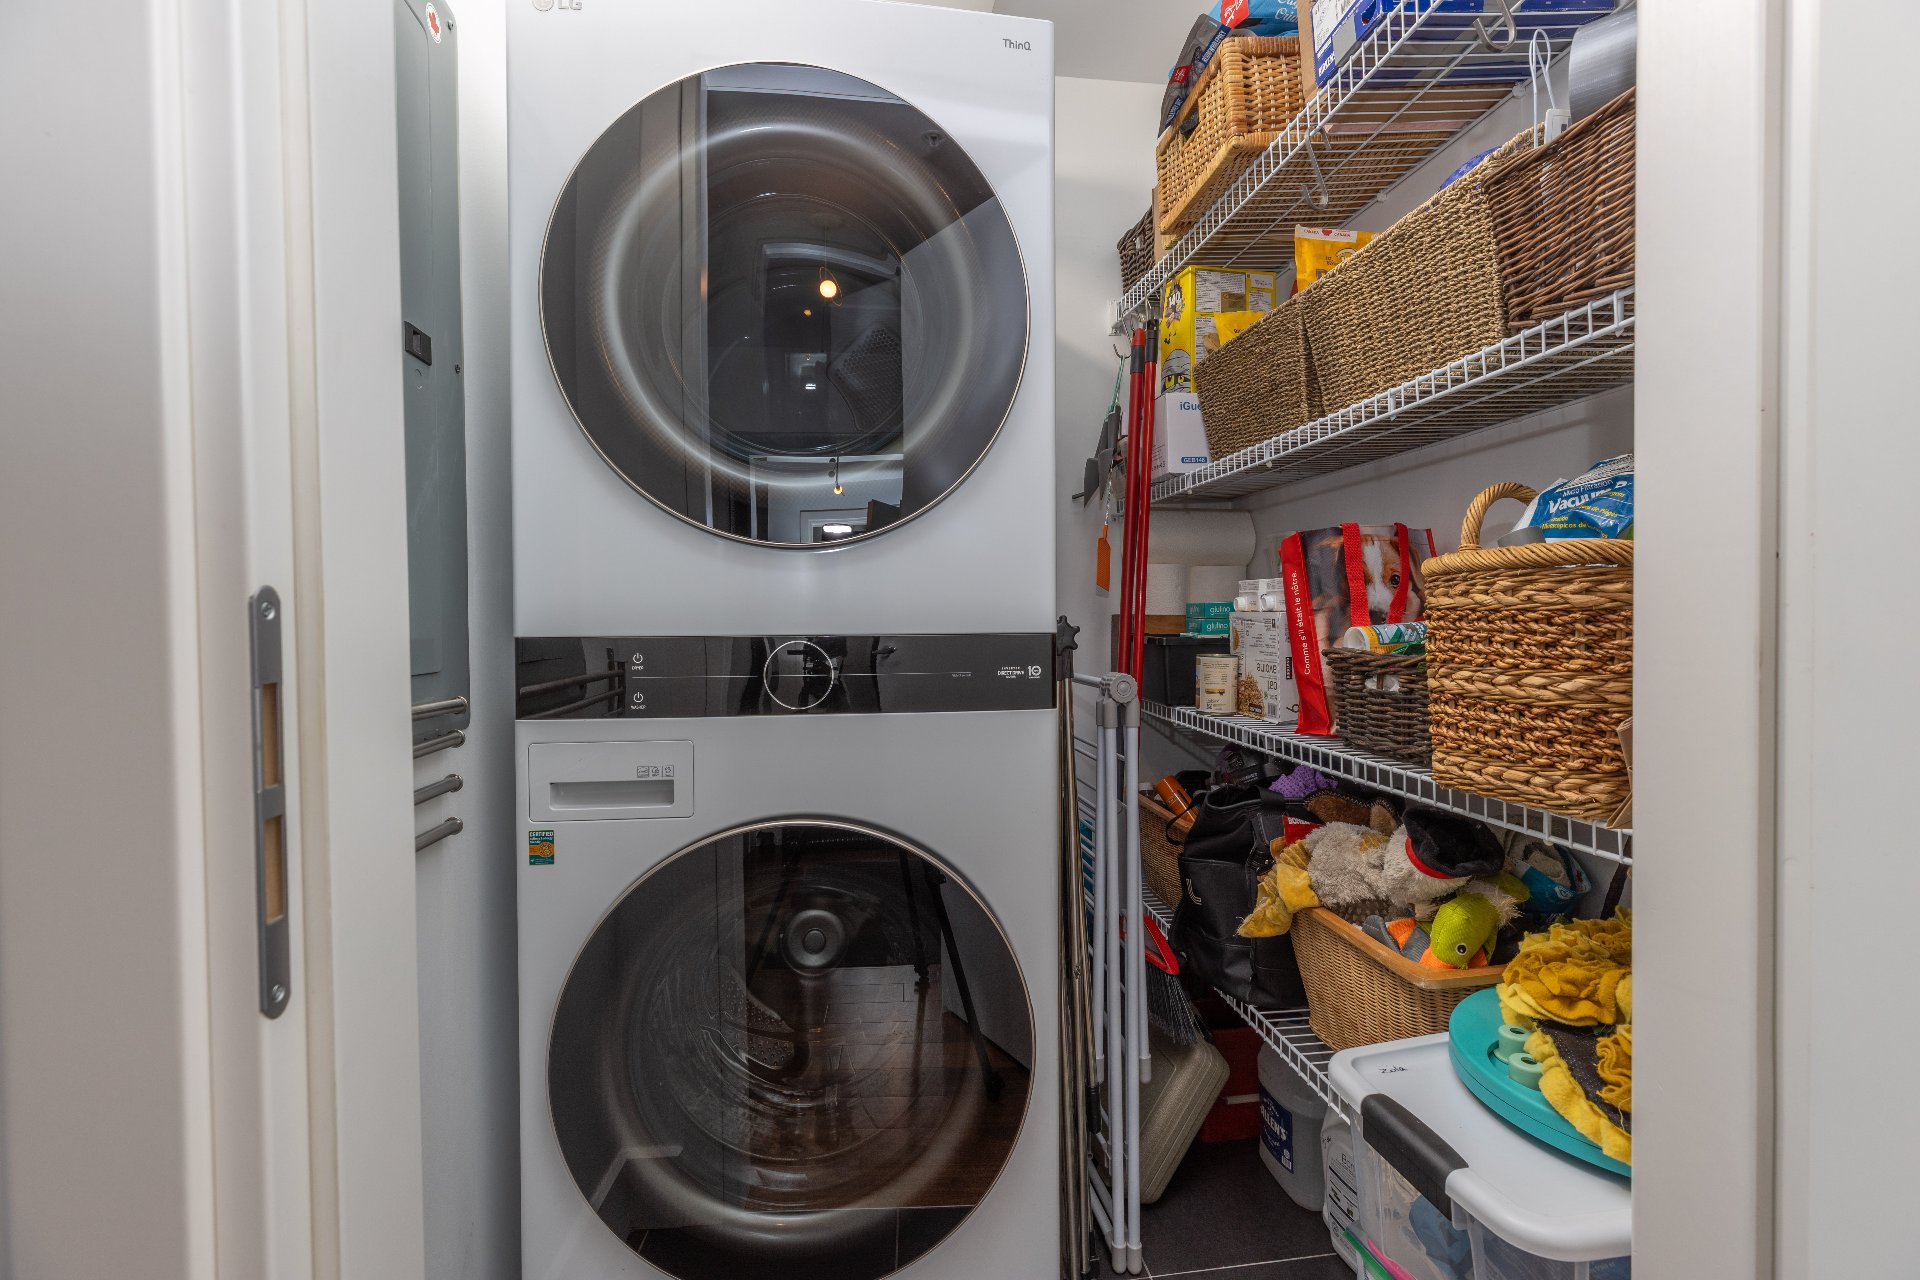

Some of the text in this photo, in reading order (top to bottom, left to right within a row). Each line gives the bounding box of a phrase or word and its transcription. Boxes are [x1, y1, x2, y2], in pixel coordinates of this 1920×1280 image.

[558, 0, 582, 11] LG
[1002, 38, 1032, 52] ThinQ
[1291, 570, 1311, 675] Comme s'il était le nôtre.
[1260, 1104, 1288, 1142] ALLEN'S
